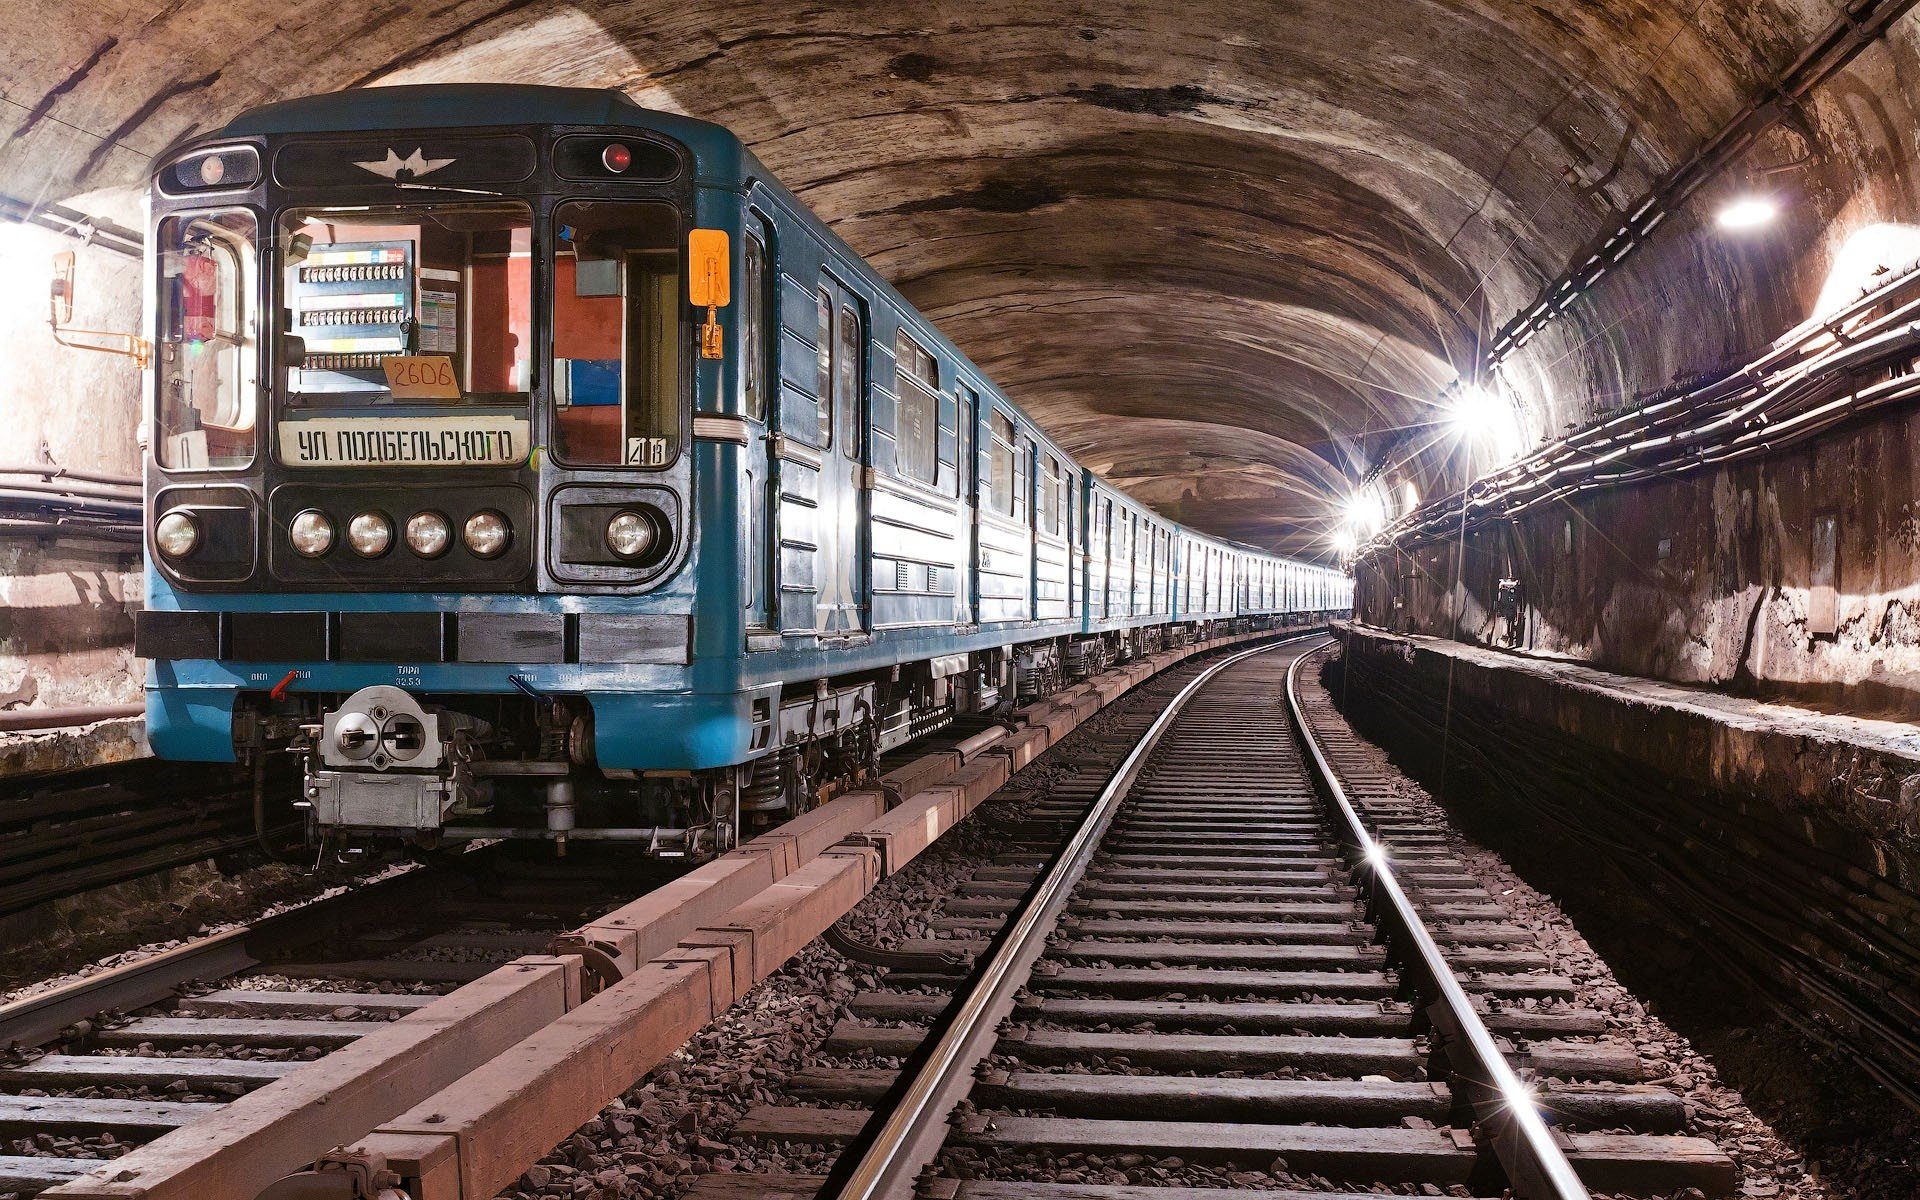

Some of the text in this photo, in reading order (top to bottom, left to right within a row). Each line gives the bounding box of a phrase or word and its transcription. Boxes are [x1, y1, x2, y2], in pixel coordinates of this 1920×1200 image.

[394, 362, 451, 387] 2606
[298, 430, 513, 462] УЛ. ПОДБЕЛЬСКОГО
[397, 665, 420, 675] ТАРА
